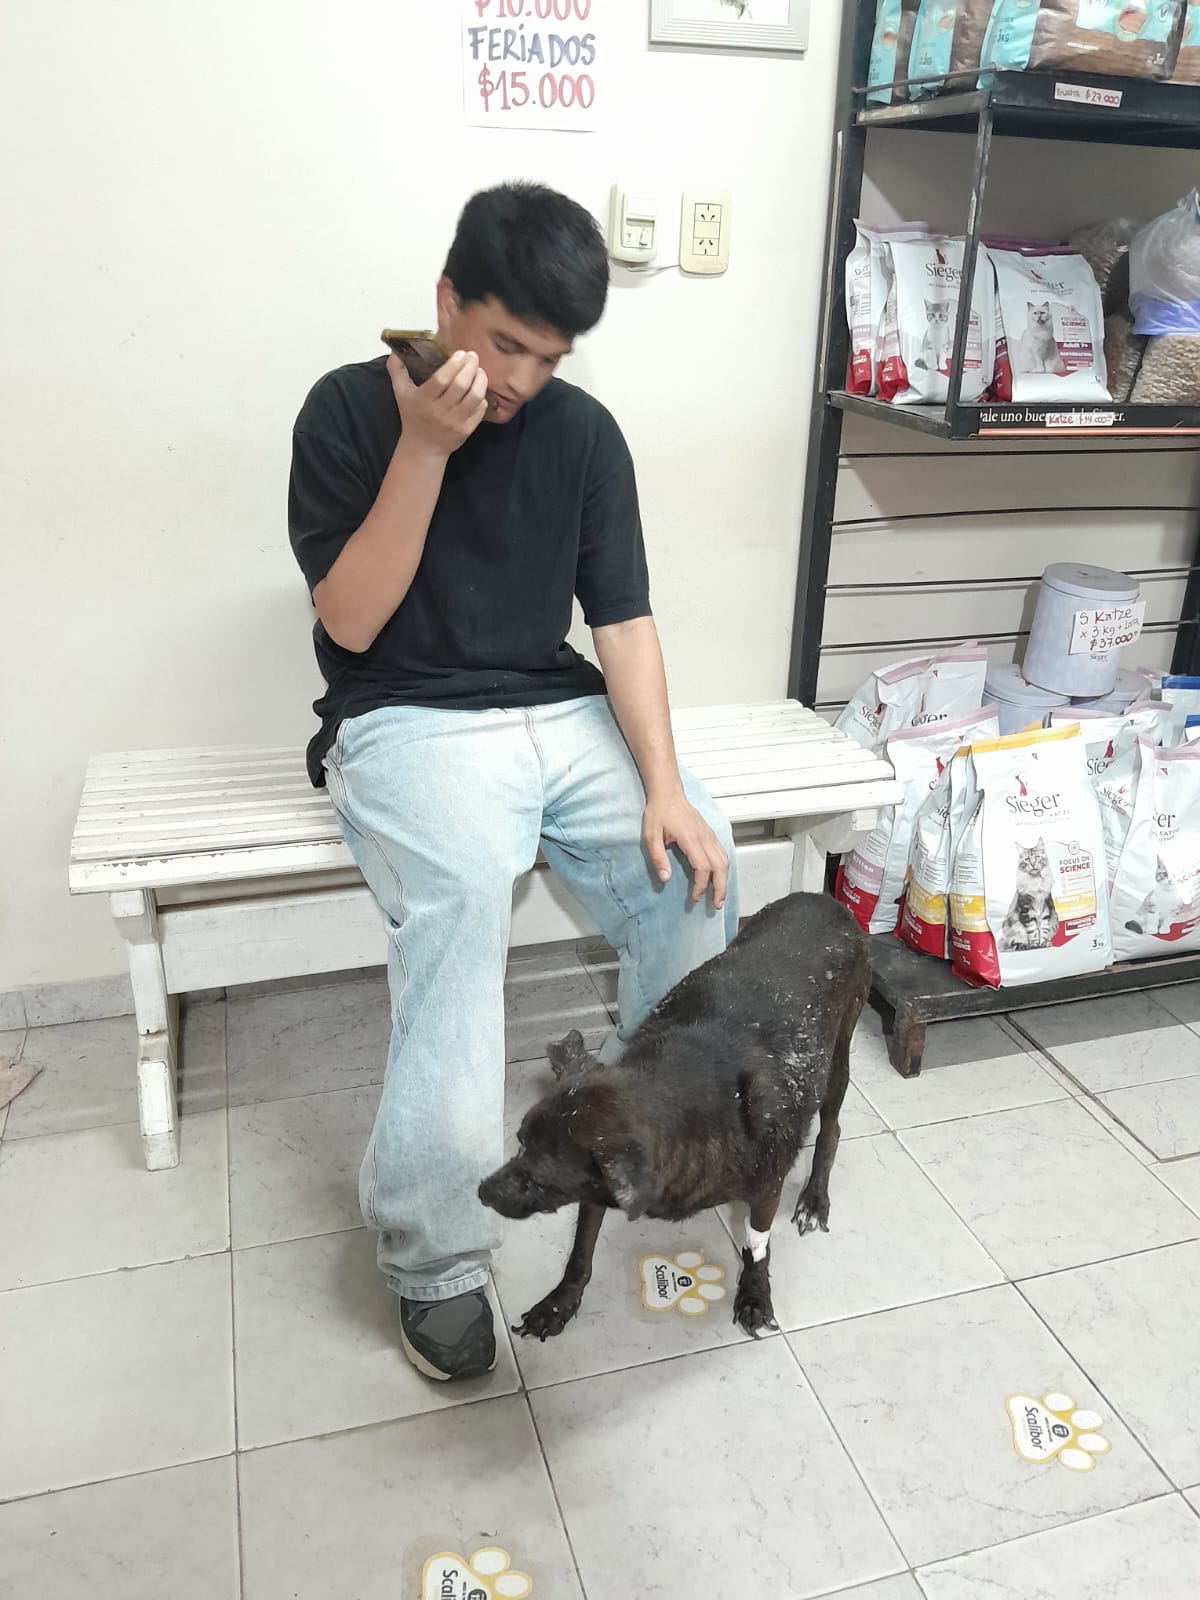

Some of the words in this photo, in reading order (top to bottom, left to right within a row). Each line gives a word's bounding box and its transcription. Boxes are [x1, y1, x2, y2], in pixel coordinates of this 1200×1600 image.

[478, 62, 595, 112] $15.000
[1001, 412, 1022, 422] uno
[1025, 408, 1046, 422] bue
[1095, 608, 1132, 624] Katze
[1092, 626, 1099, 638] 3
[1087, 757, 1115, 776] Sie
[1005, 793, 1060, 818] Sieger
[1059, 857, 1081, 866] FOCUS
[1060, 862, 1091, 874] SCIENCE
[655, 1264, 669, 1300] Scalibor
[1024, 1405, 1043, 1451] Scalibor
